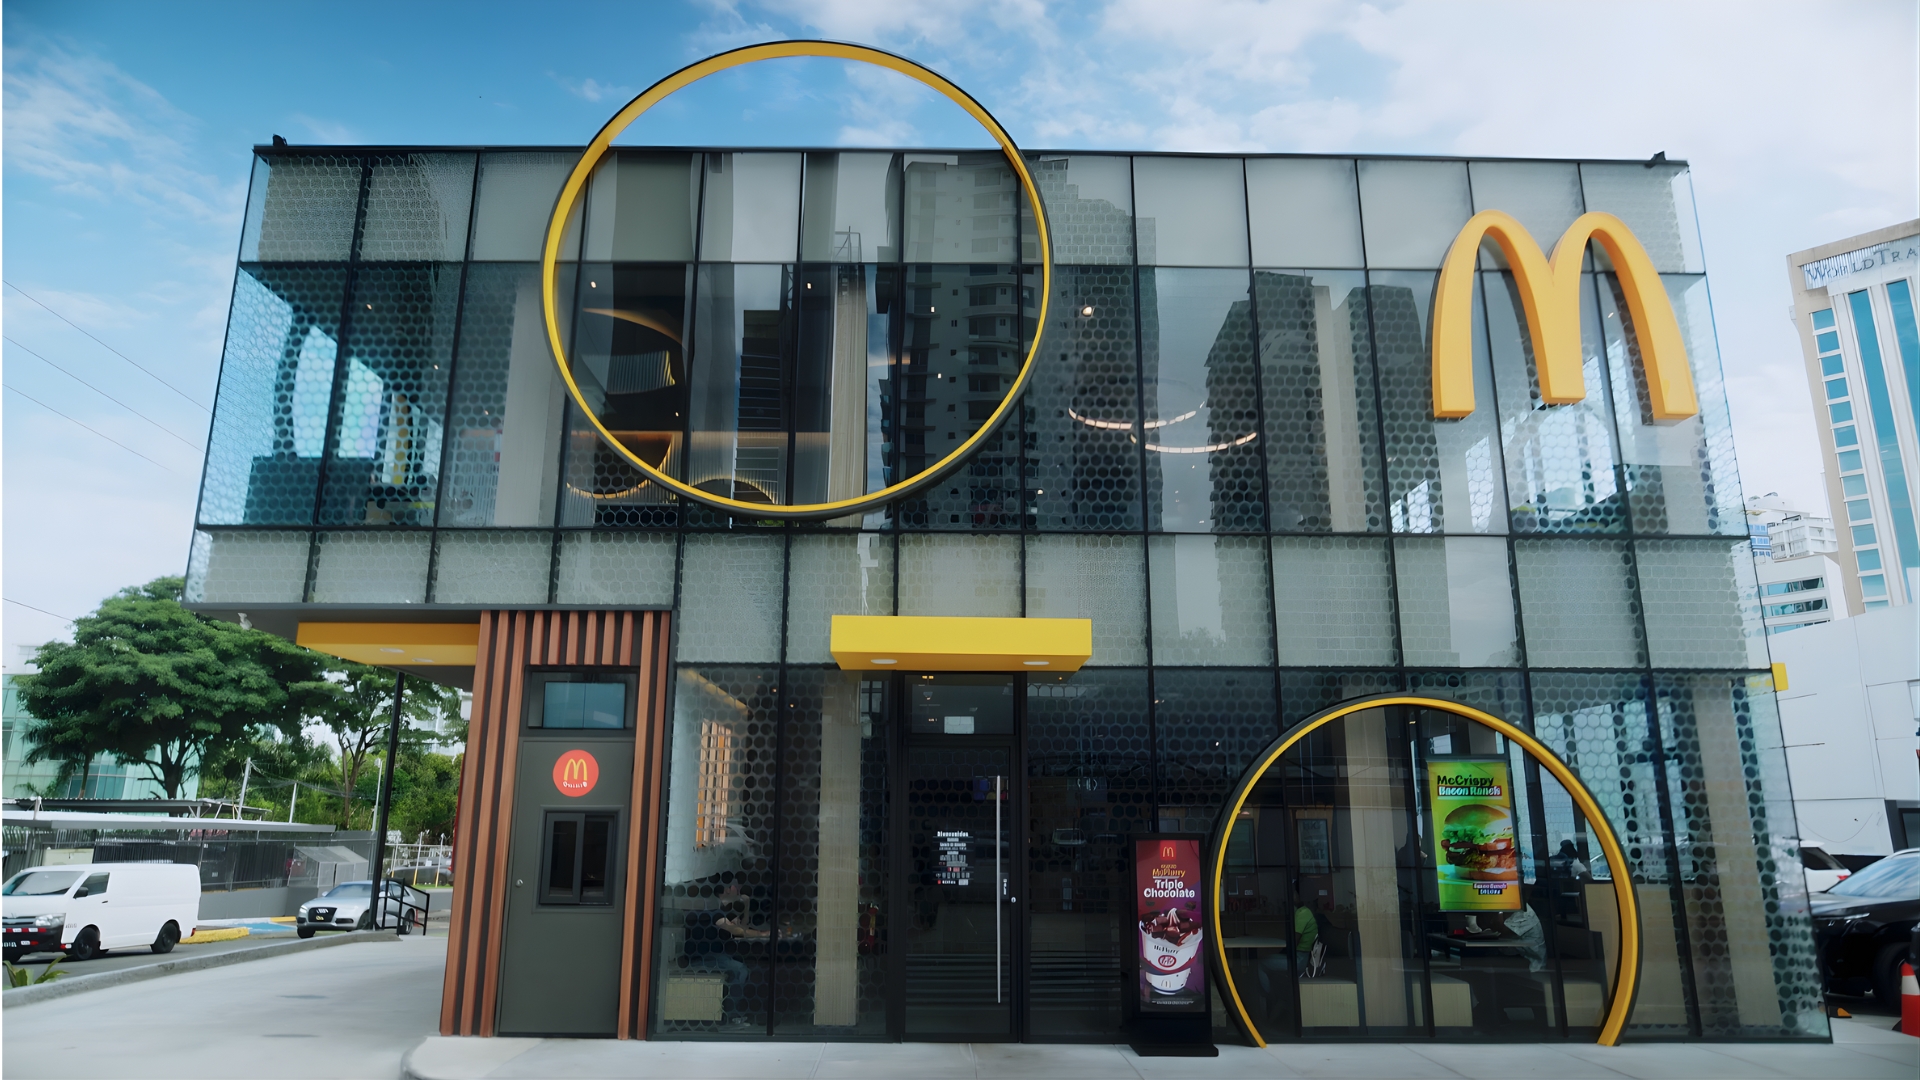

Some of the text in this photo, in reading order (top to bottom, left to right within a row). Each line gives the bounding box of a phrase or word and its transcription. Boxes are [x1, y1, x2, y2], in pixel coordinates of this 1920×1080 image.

[1437, 774, 1494, 786] McCrispy
[1438, 786, 1501, 796] Bacon Ranch
[1154, 879, 1184, 890] Triple
[1143, 887, 1195, 898] Chocolate
